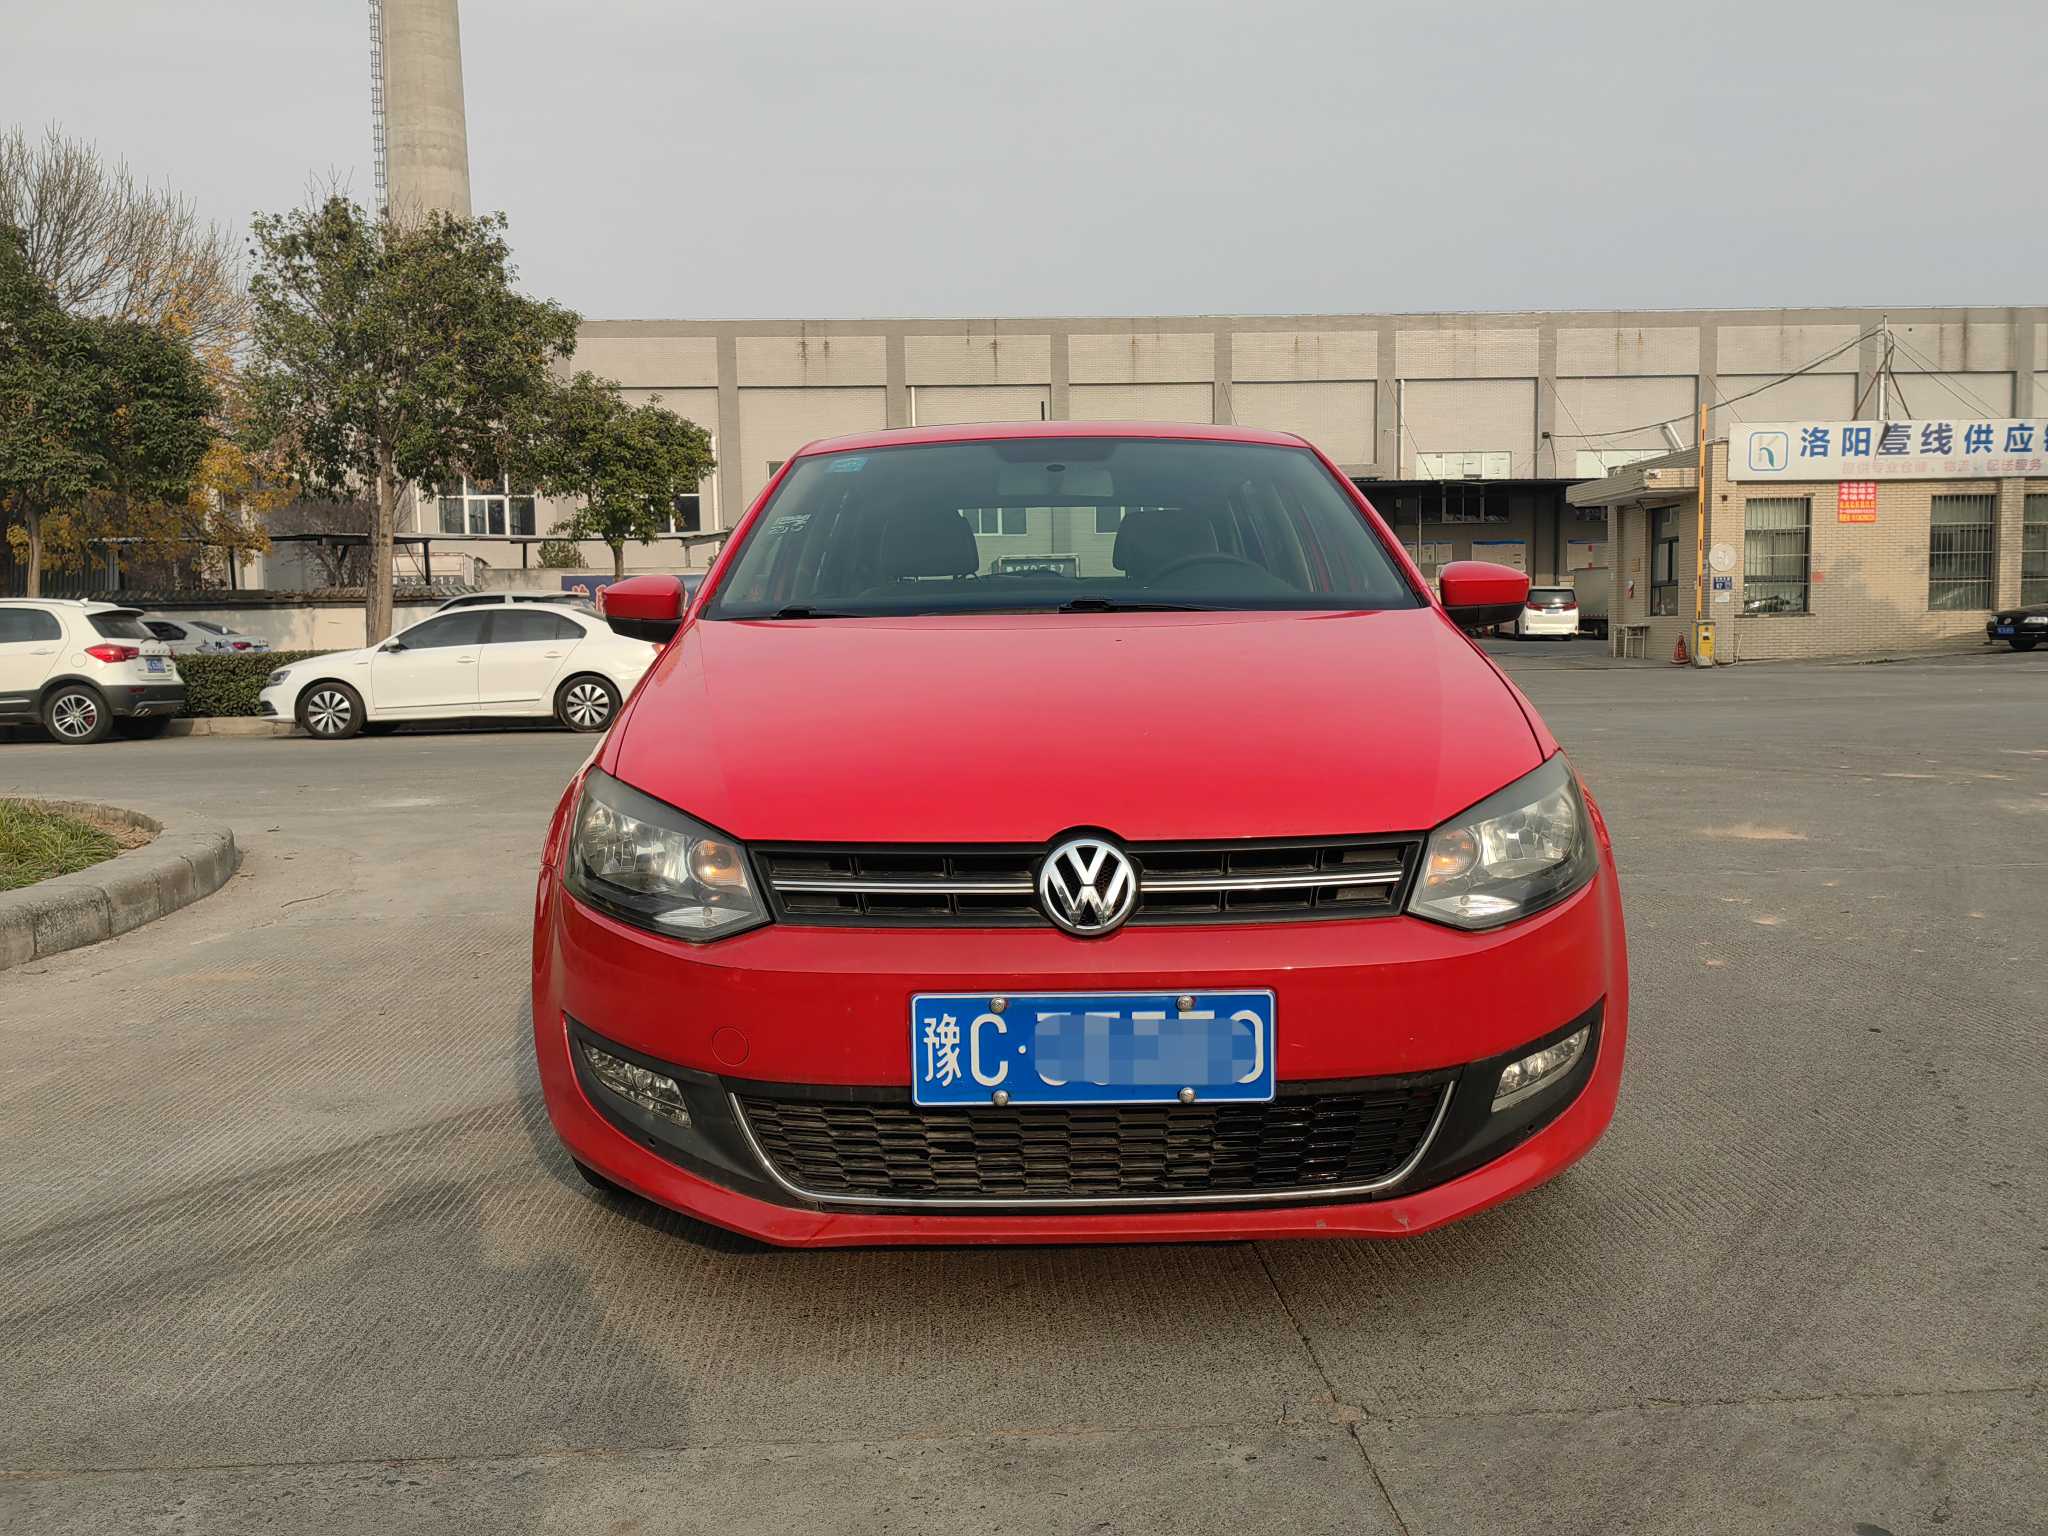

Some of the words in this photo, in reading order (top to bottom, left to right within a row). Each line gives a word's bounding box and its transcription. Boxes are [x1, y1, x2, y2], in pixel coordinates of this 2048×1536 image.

[1800, 422, 2048, 458] 洛阳壹线供应
